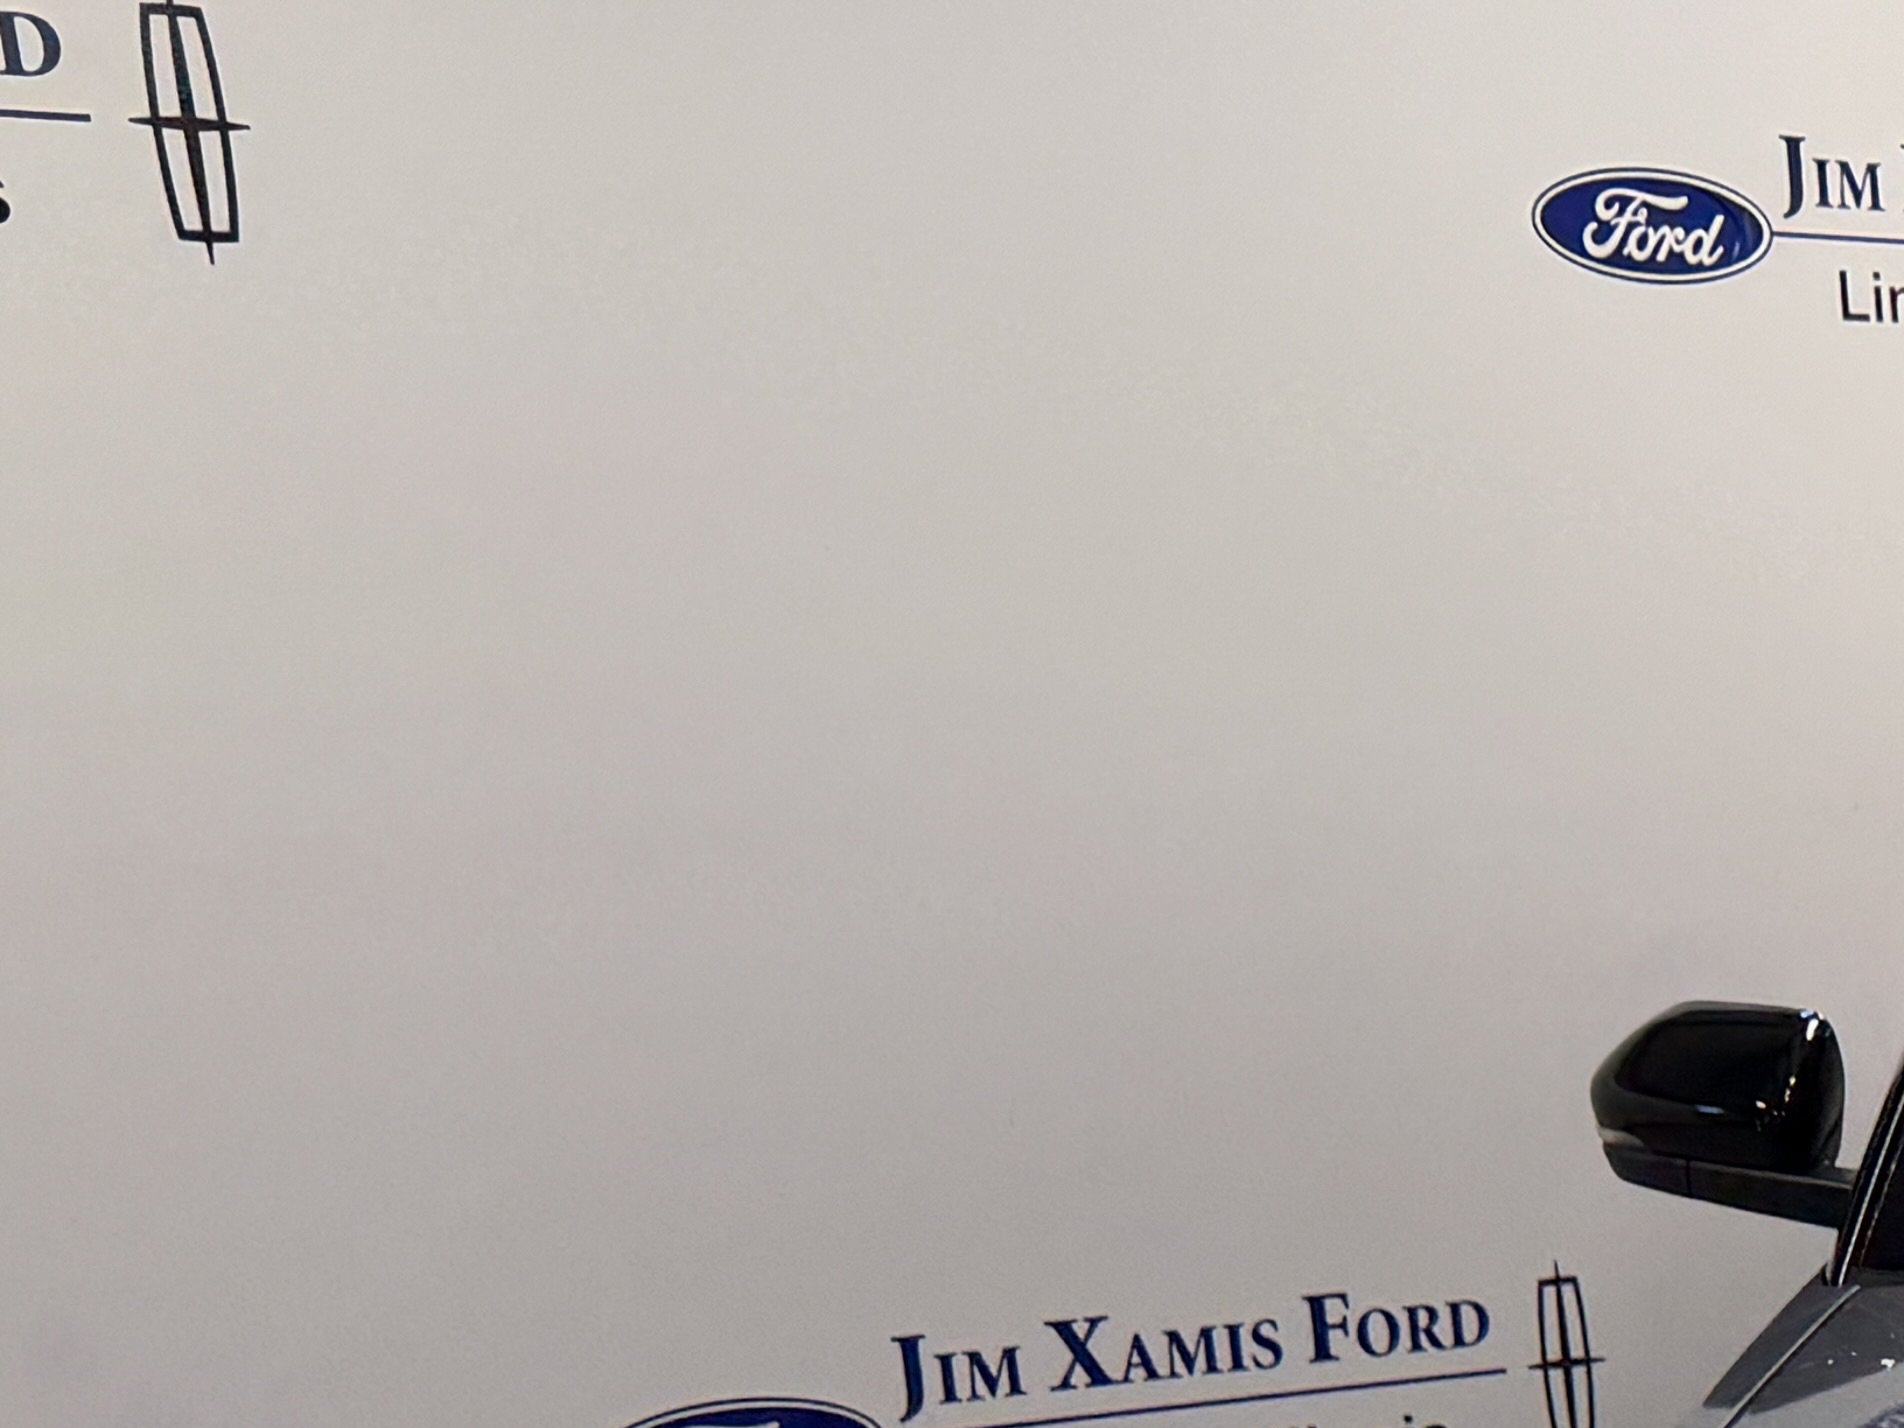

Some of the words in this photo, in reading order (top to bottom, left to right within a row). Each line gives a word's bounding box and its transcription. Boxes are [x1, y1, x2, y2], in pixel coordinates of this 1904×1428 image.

[1779, 135, 1884, 219] JIM
[1582, 187, 1725, 267] Ford
[891, 1335, 1028, 1422] JIM
[1044, 1316, 1284, 1393] XAMIS
[1302, 1293, 1489, 1363] FORD
